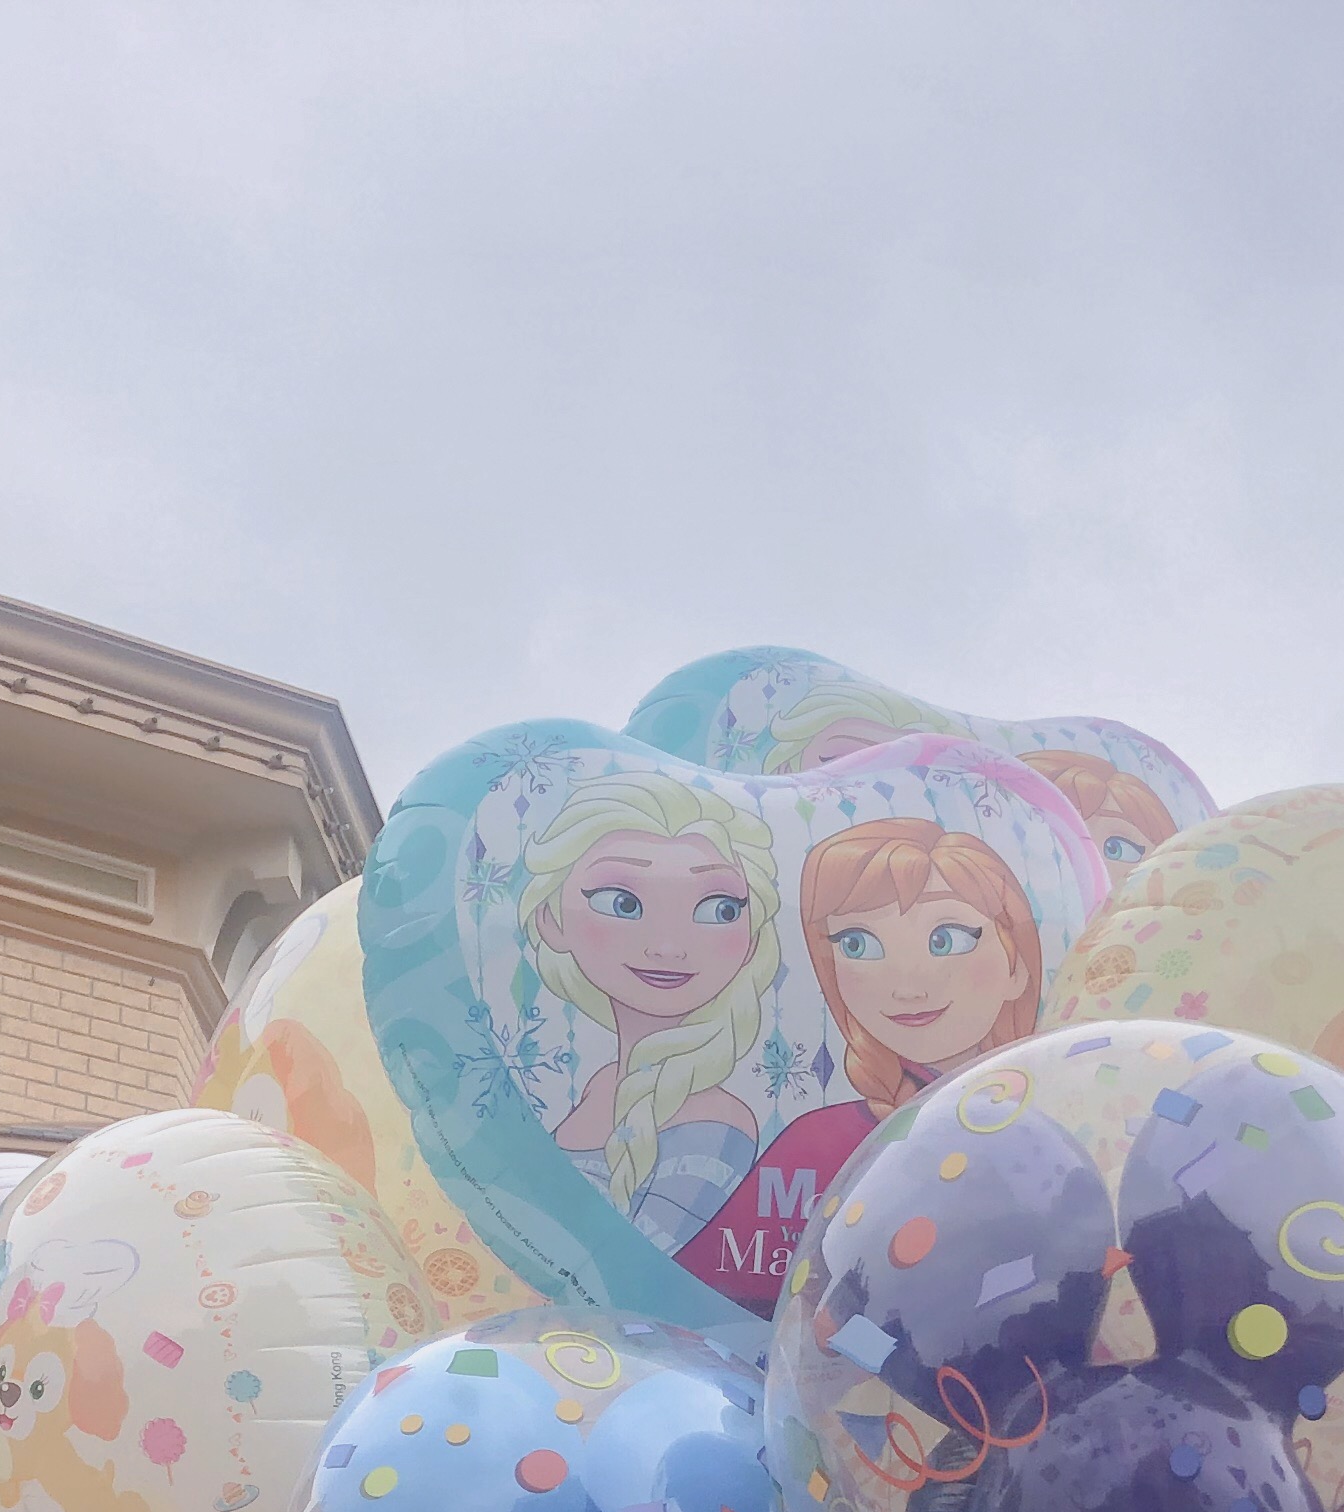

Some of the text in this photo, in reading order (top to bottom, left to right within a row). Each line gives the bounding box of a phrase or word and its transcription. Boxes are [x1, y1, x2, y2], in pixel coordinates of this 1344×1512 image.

[495, 1209, 522, 1237] board
[521, 1238, 555, 1268] Aircraft
[715, 1227, 794, 1276] Ma
[330, 1351, 342, 1387] Kong
